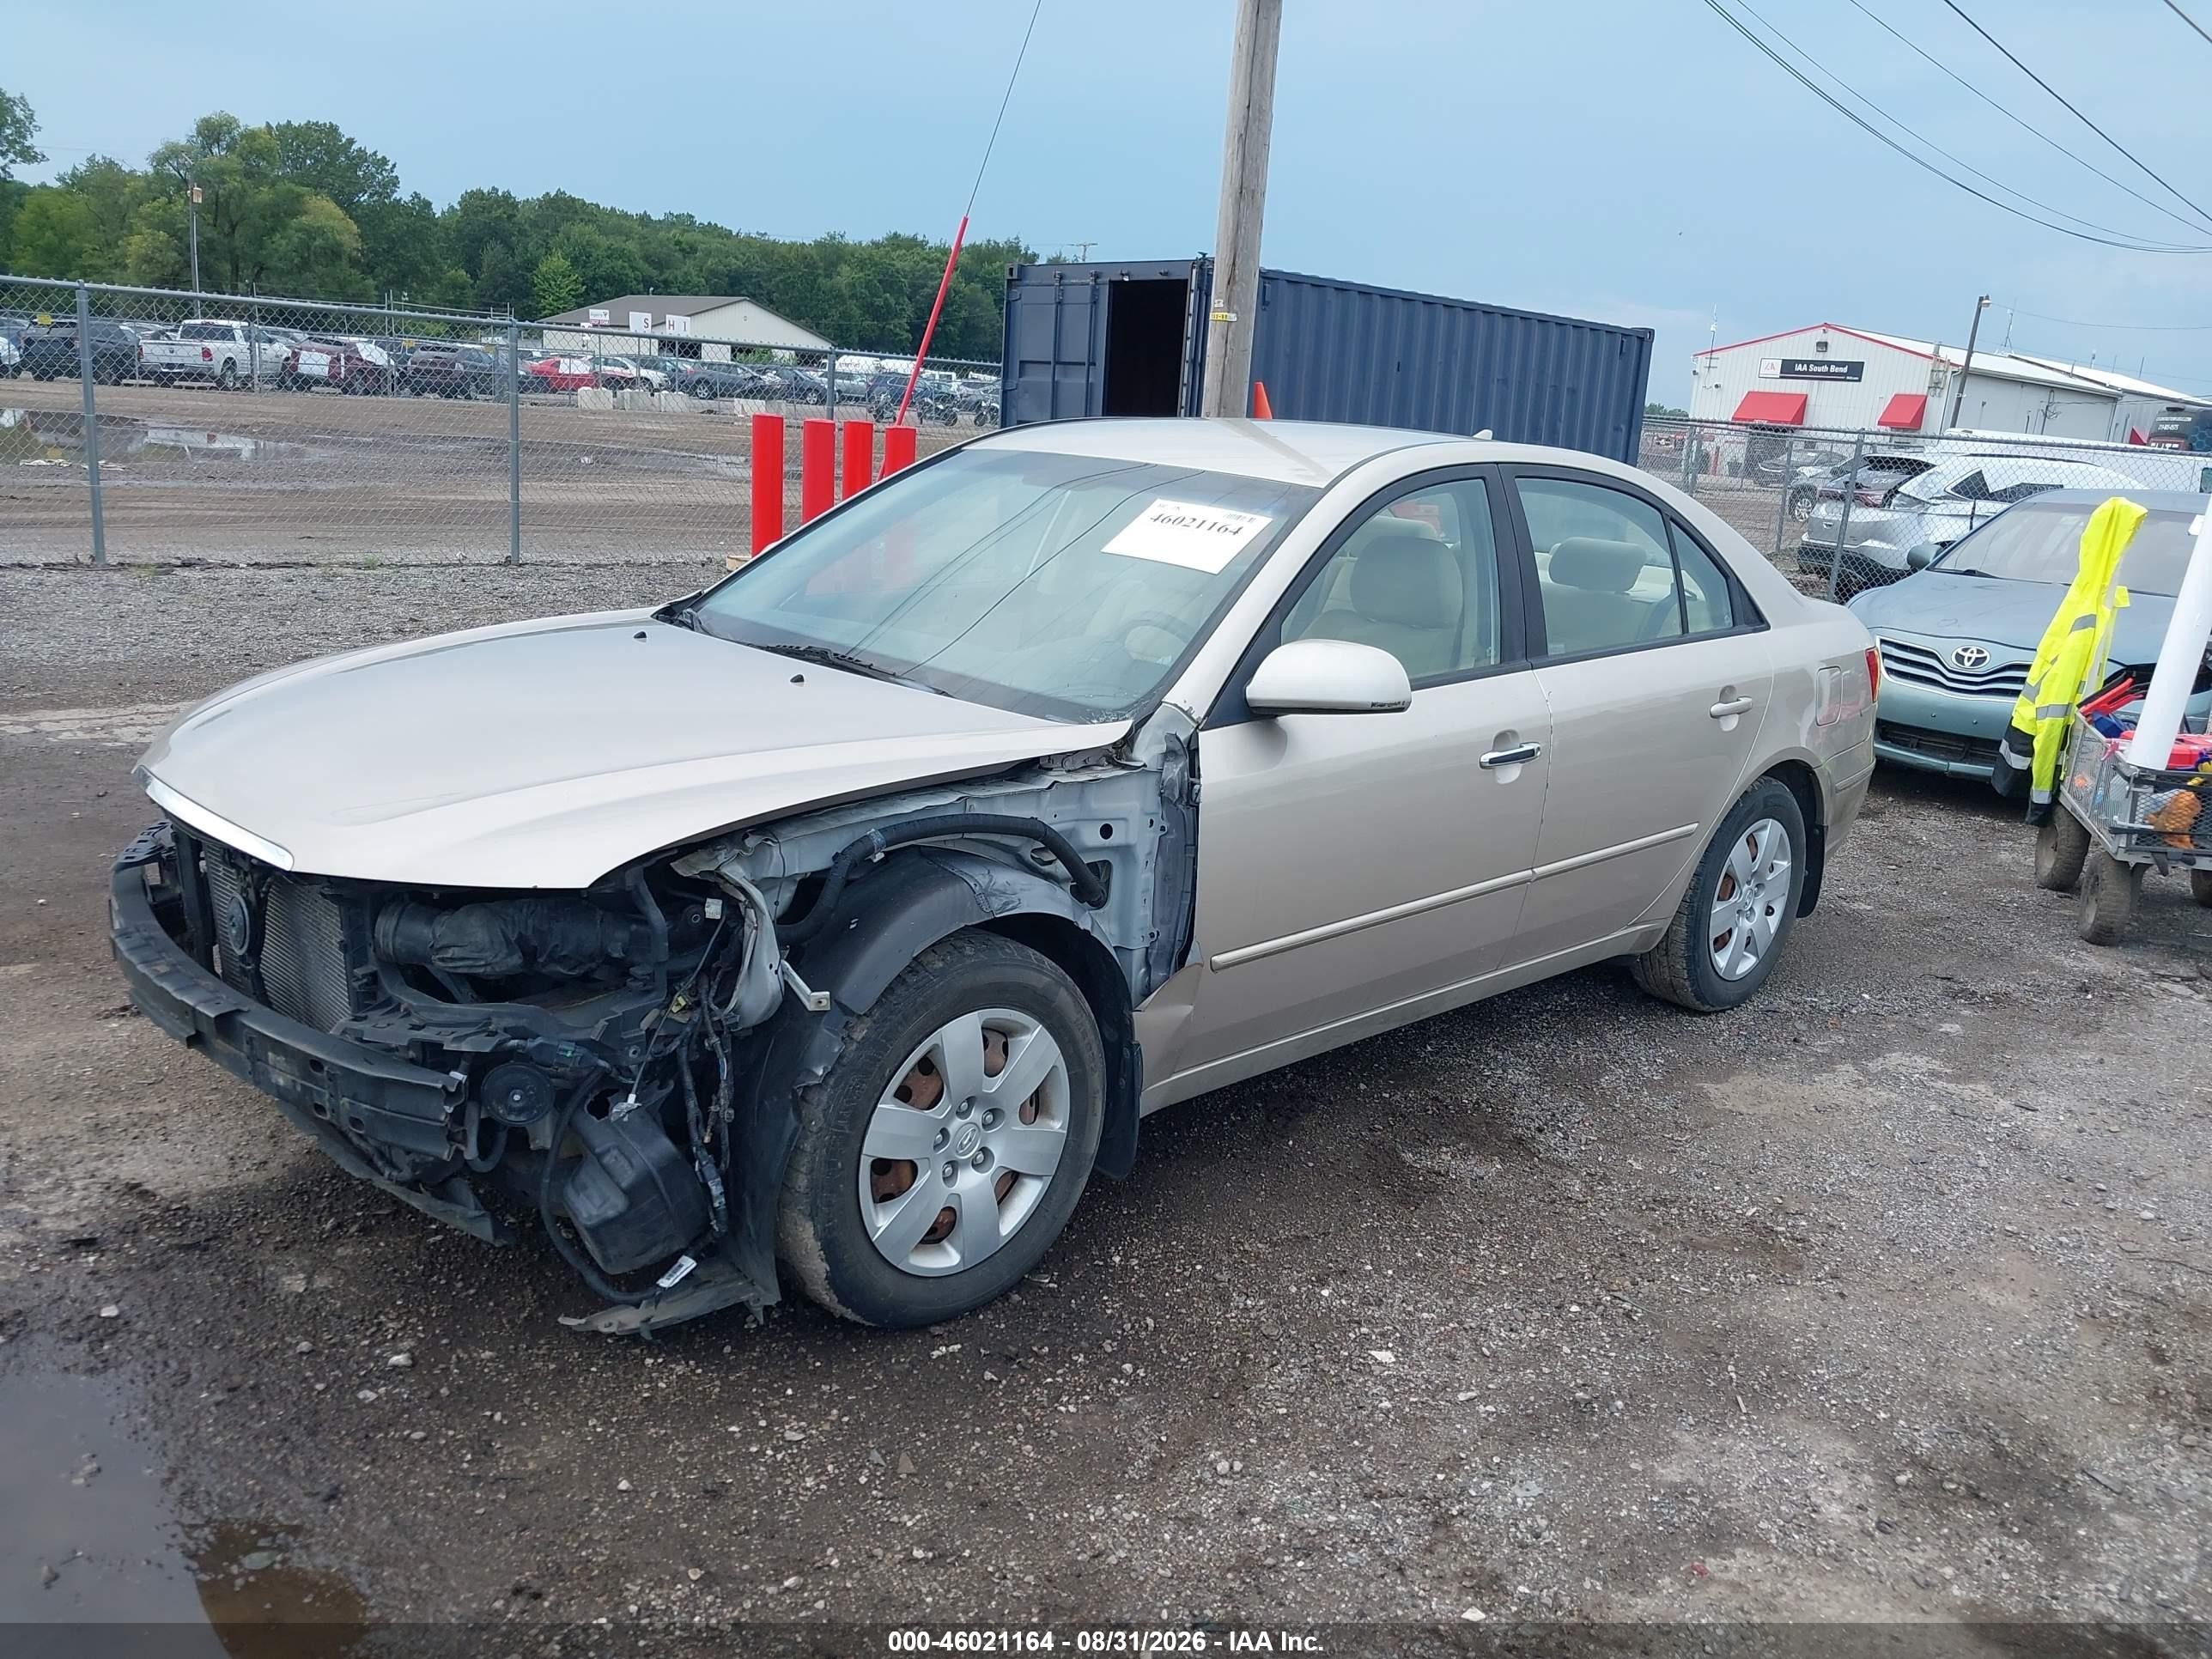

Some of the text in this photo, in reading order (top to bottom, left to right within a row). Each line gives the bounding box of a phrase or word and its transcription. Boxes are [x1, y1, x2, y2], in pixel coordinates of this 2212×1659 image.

[643, 318, 649, 329] S
[668, 319, 675, 331] H
[1794, 363, 1849, 374] IAA South Bend
[1150, 514, 1243, 537] 46021164
